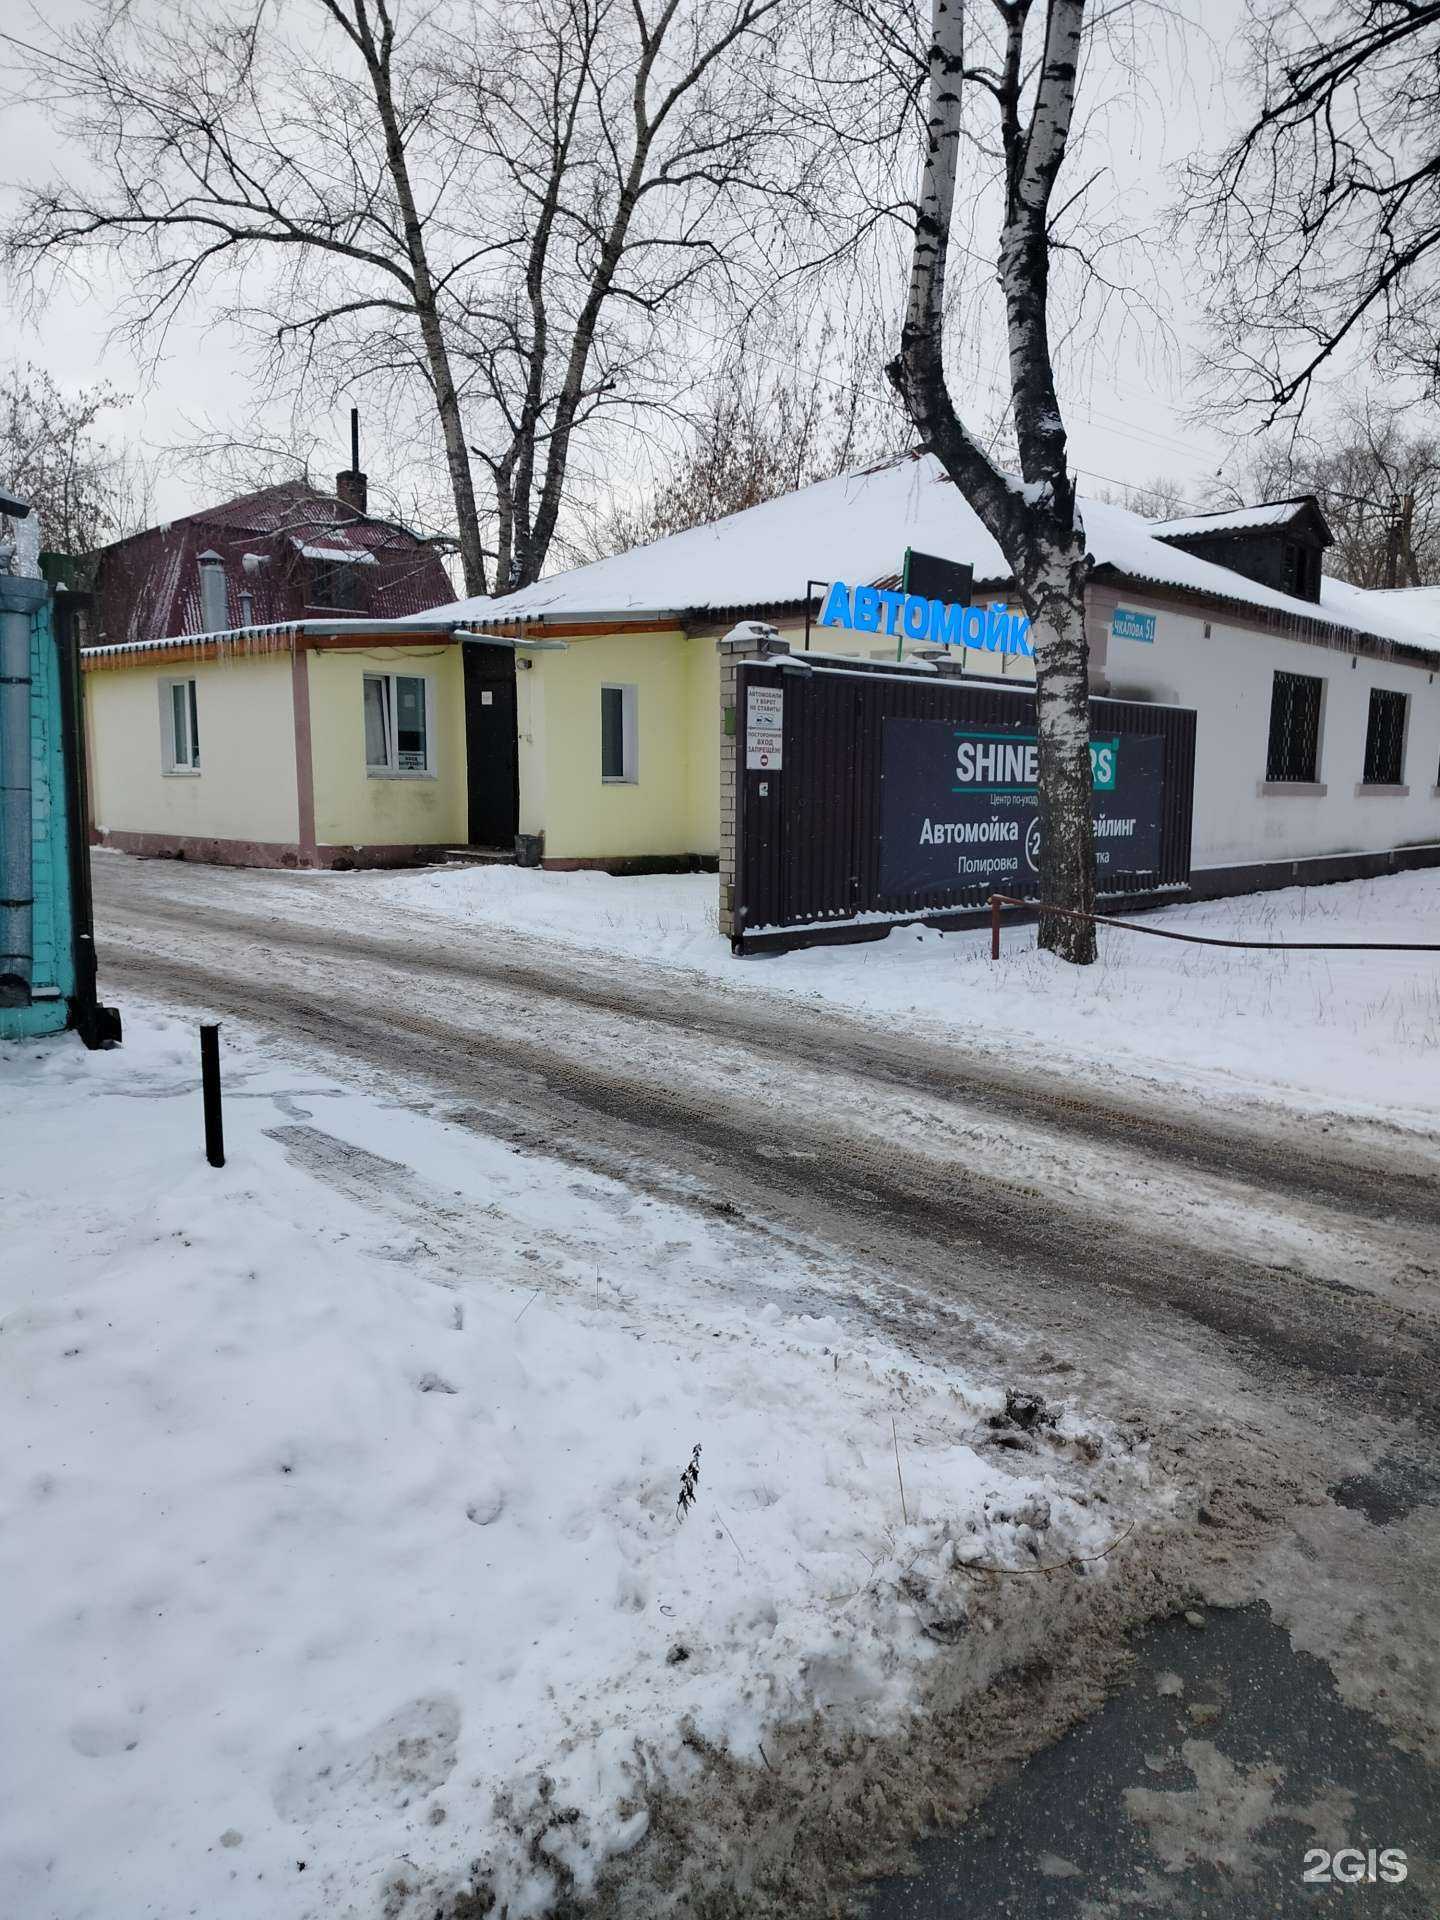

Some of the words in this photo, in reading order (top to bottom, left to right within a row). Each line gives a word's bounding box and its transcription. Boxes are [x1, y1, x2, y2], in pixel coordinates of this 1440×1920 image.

[818, 581, 1035, 656] АВТОМОЙК
[1114, 619, 1144, 638] ЧКАЛОВА
[1145, 619, 1154, 640] 51
[956, 742, 1039, 782] SHINE
[1089, 749, 1112, 783] RS
[990, 793, 1011, 806] Центр
[919, 816, 1019, 845] Автомойка
[1092, 813, 1137, 837] ейлинг
[958, 856, 1018, 875] Полировка
